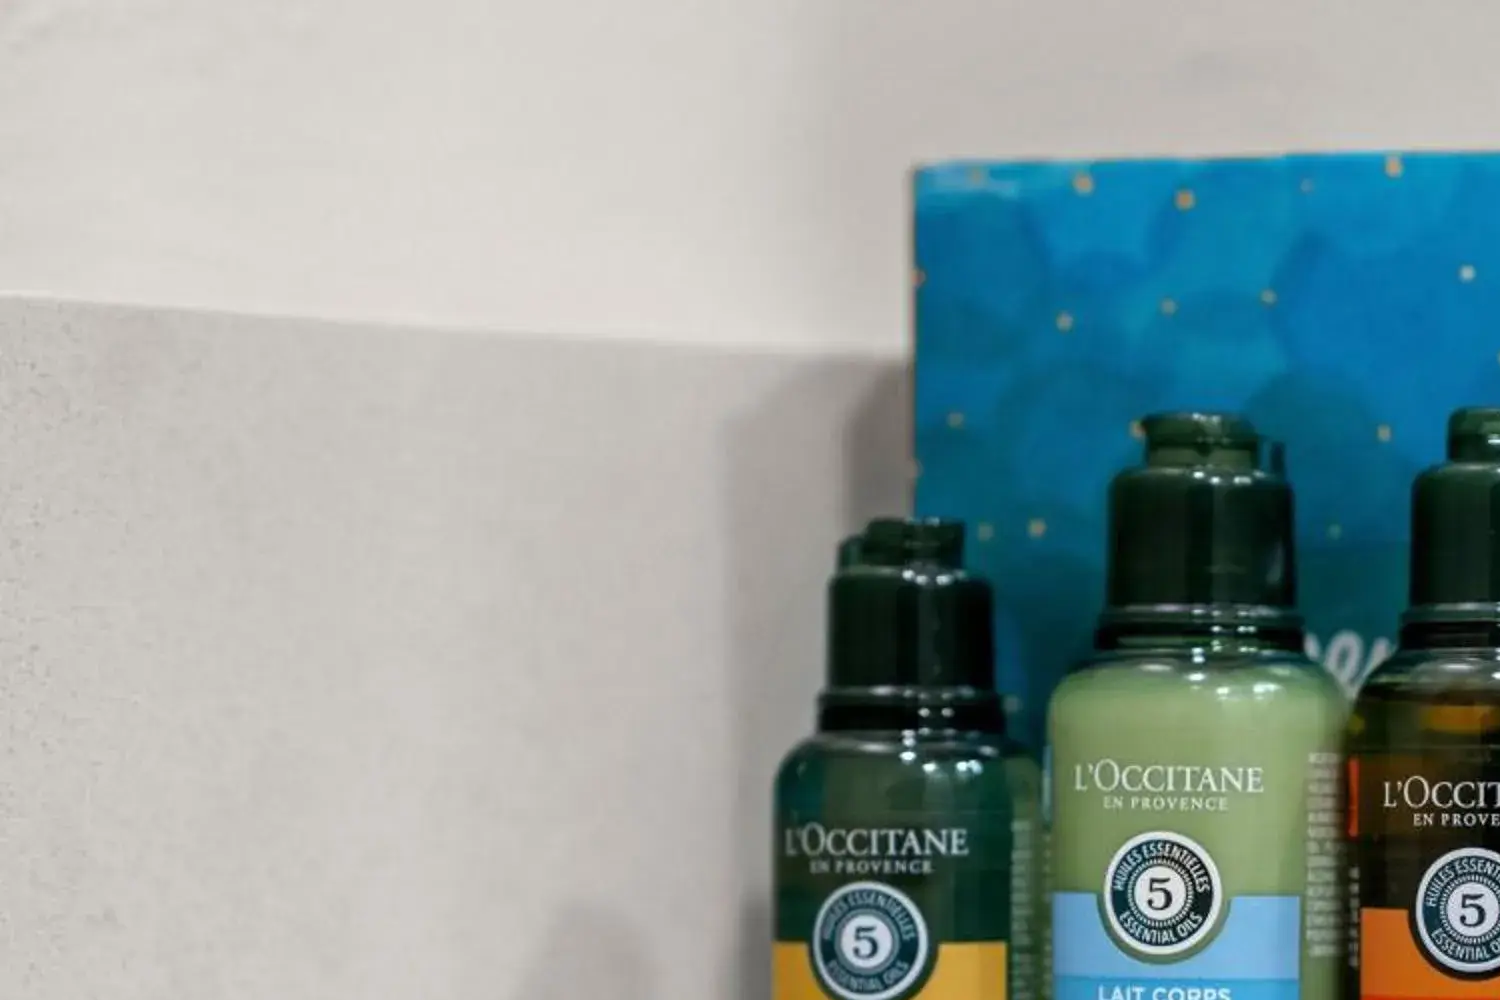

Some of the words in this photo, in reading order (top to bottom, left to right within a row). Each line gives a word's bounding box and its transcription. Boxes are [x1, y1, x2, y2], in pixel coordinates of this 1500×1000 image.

[1074, 759, 1264, 793] L'OCCITANE
[1103, 796, 1122, 809] EN
[1131, 797, 1228, 811] PROVENCE
[1413, 813, 1433, 827] EN
[785, 823, 969, 857] L'OCCITANE
[835, 860, 933, 875] PROVENCE
[1147, 877, 1172, 910] 5
[1459, 893, 1486, 927] 5
[853, 926, 878, 959] 5
[1431, 928, 1490, 961] ESSENTIAL
